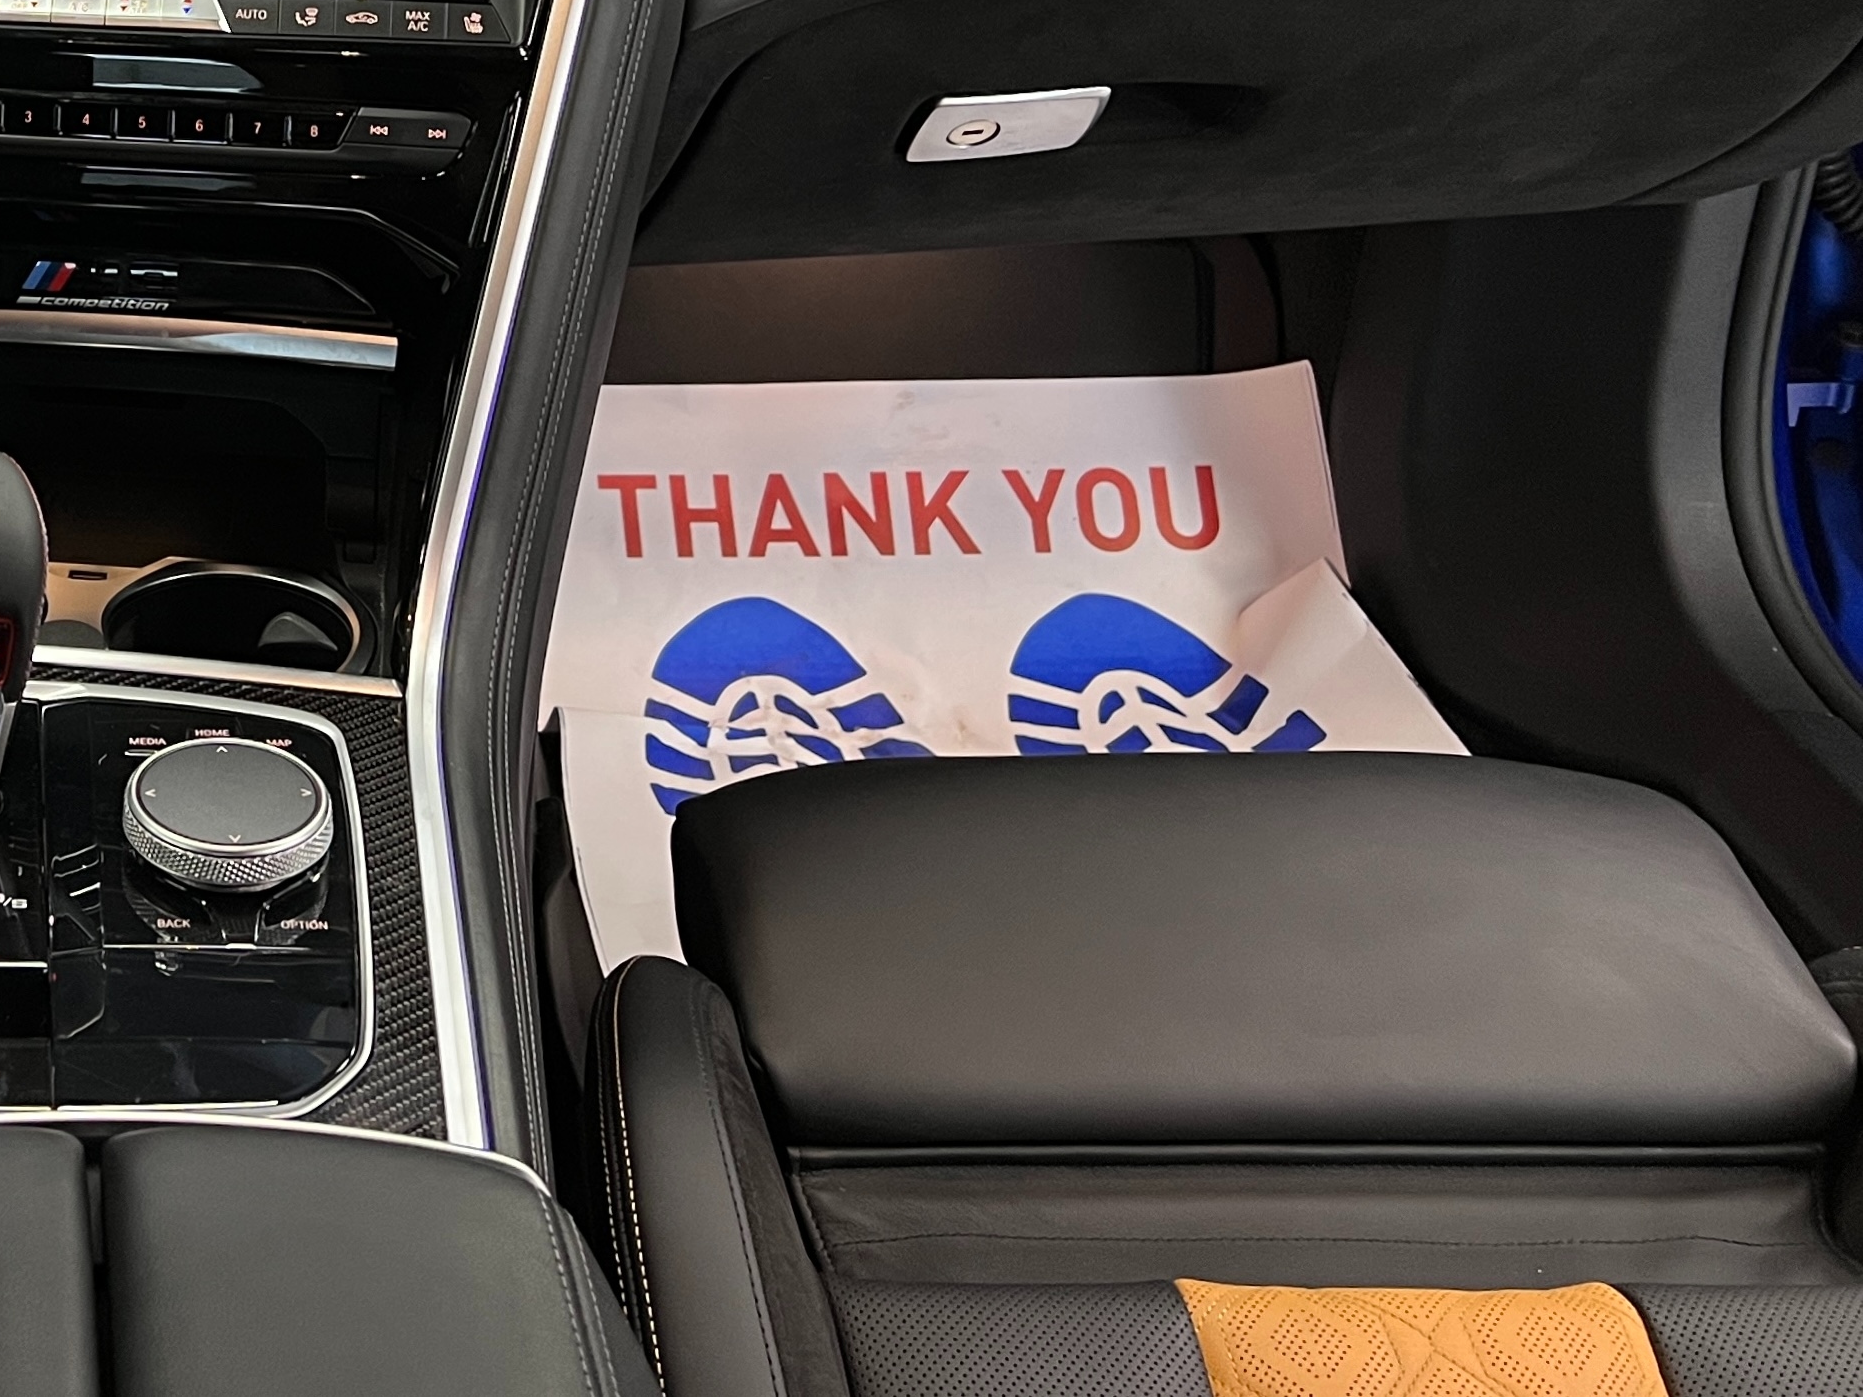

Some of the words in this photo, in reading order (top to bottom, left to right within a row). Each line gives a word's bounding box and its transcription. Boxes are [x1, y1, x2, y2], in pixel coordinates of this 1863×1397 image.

[236, 9, 267, 21] AUTO
[406, 11, 431, 21] MAX
[407, 21, 429, 32] A/C
[25, 111, 33, 123] 3
[81, 113, 90, 125] 4
[138, 116, 146, 129] 5
[195, 119, 204, 132] 6
[253, 122, 262, 135] 7
[310, 125, 319, 137] 8
[41, 296, 170, 311] competition
[597, 470, 981, 558] THANK
[1002, 465, 1220, 554] YOU
[195, 729, 230, 737] HOME
[129, 737, 166, 746] MEDIA
[266, 739, 292, 747] MAP
[157, 918, 191, 929] BACK
[280, 919, 328, 930] OPTION
